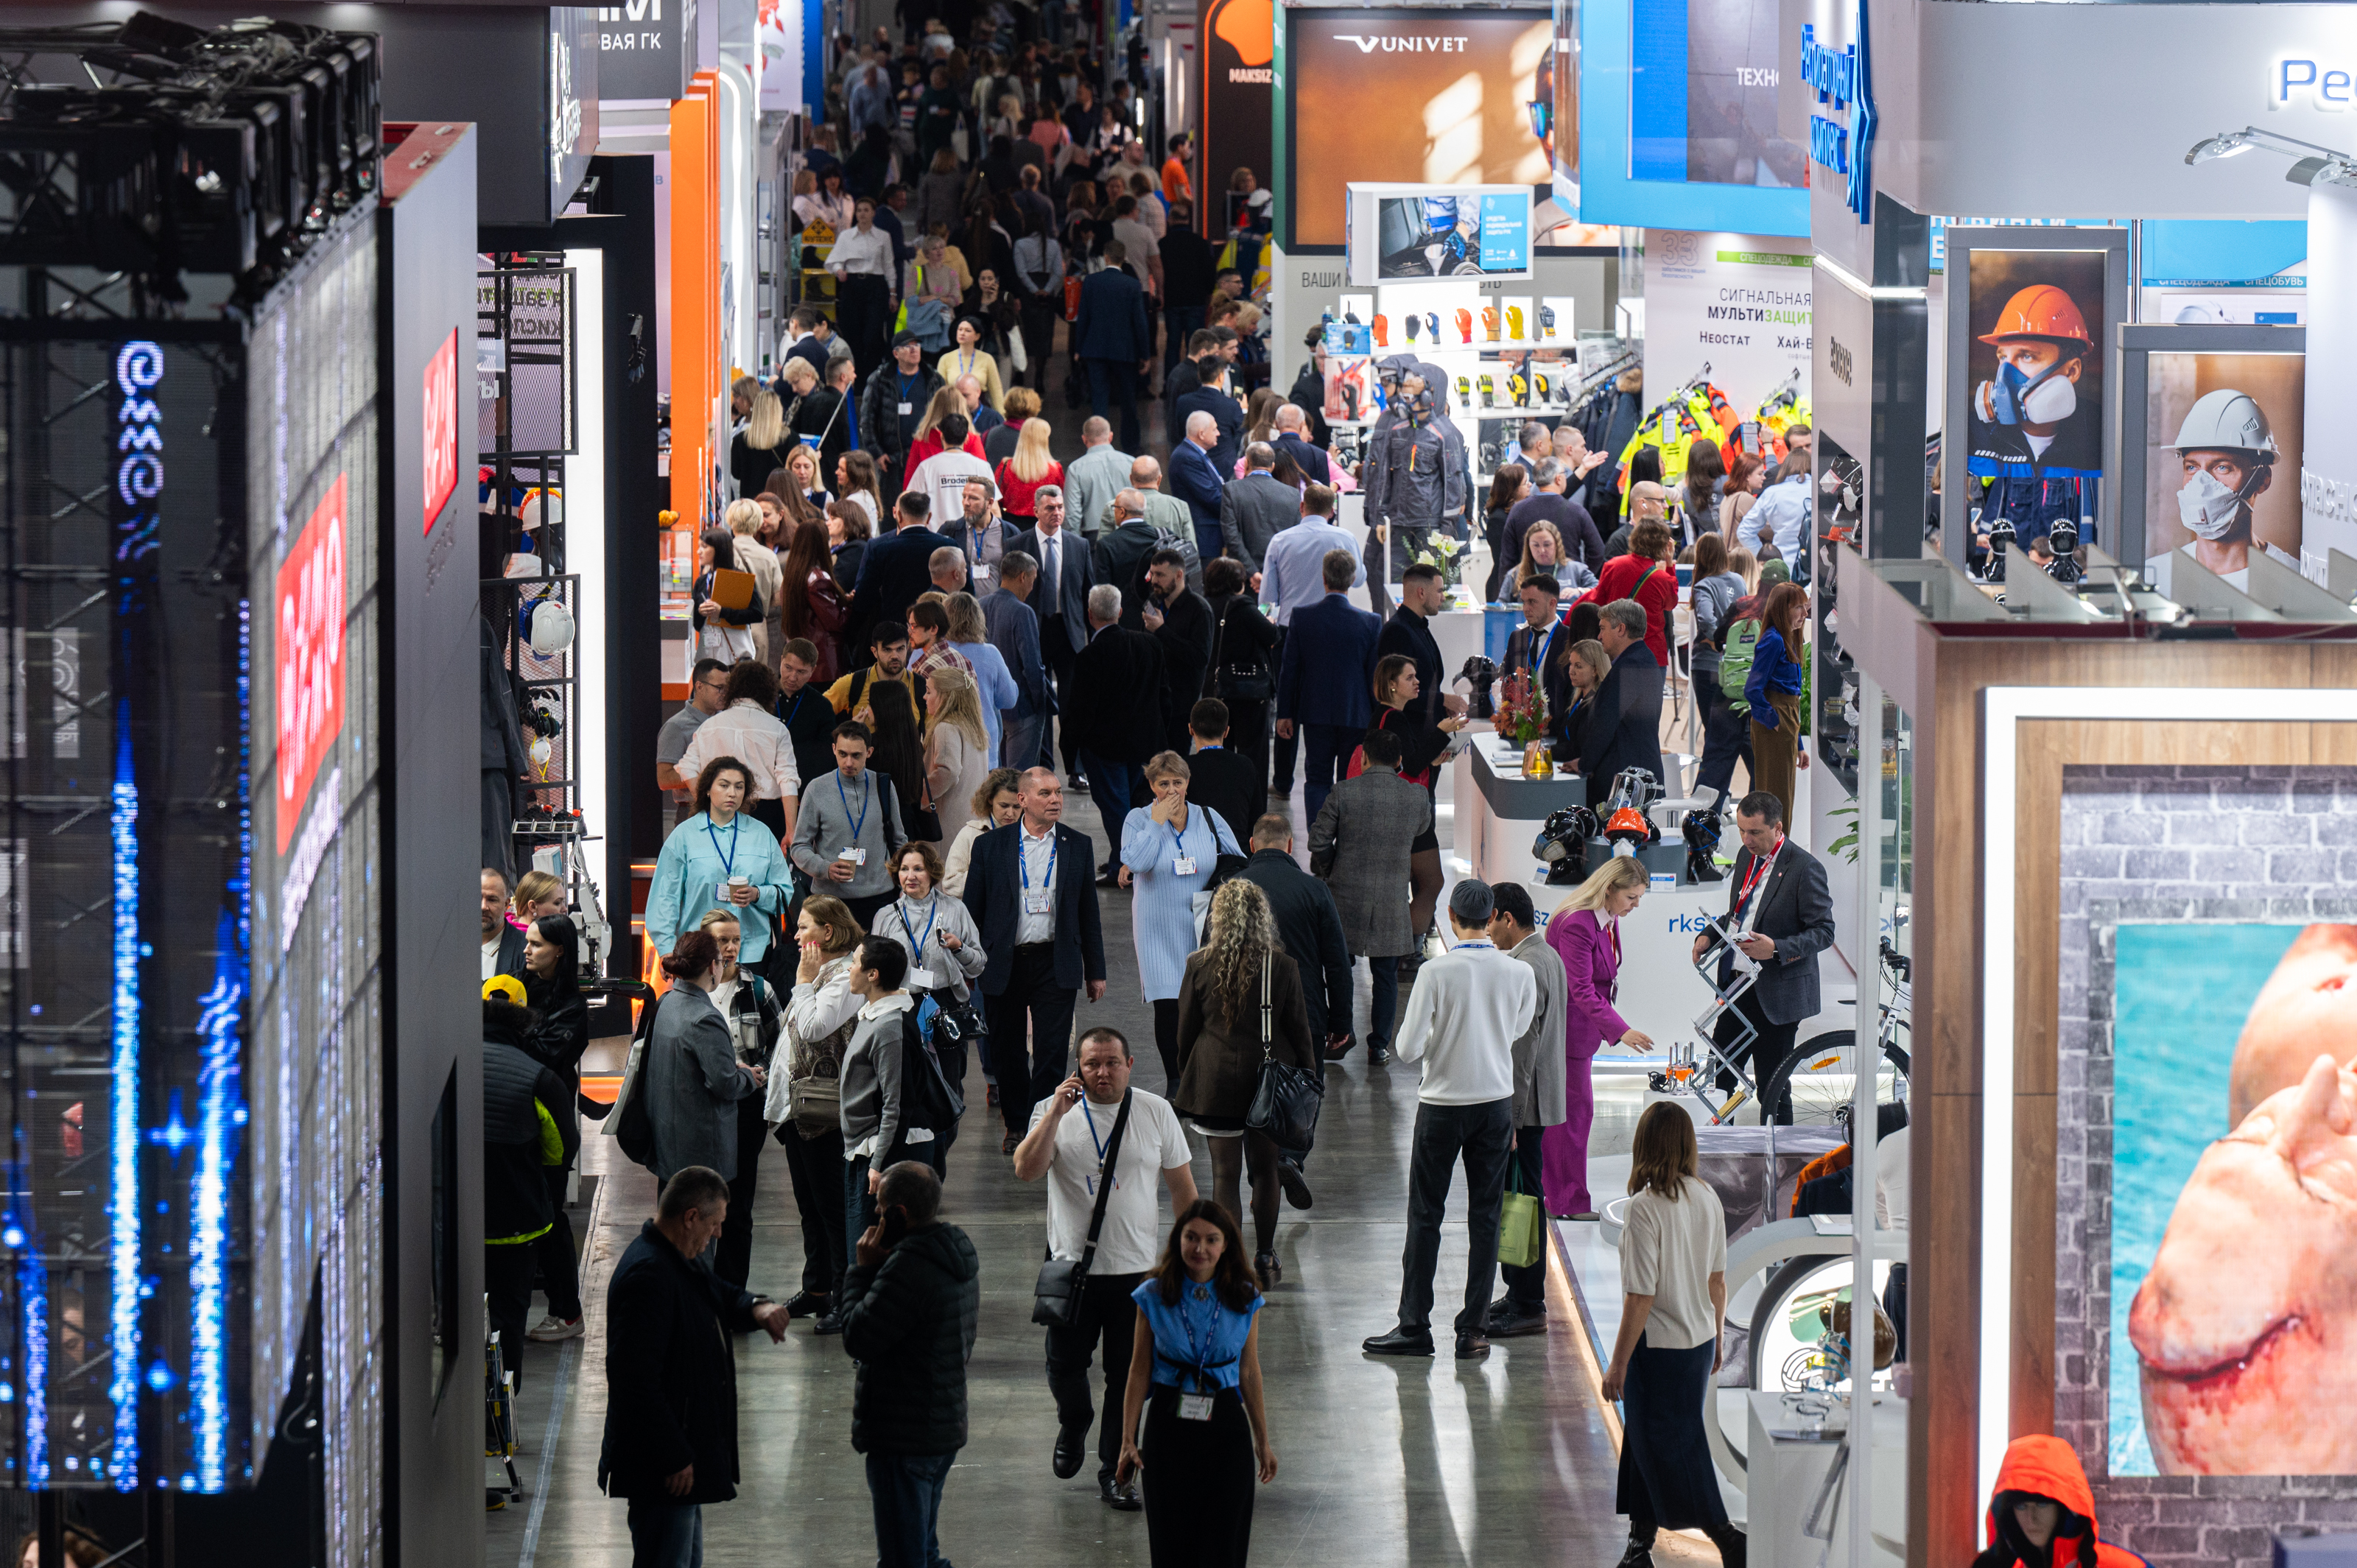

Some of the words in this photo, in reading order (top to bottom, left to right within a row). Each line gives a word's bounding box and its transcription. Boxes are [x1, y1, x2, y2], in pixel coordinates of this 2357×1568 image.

[598, 33, 634, 50] ВАЯ
[642, 32, 661, 49] ГК
[1381, 37, 1468, 52] UNIVET
[2280, 60, 2357, 102] Ре
[1740, 253, 1793, 265] СПЕЦОДЕЖДА
[1302, 273, 1341, 288] ВАШИ
[1719, 288, 1811, 306] СИГНАЛЬНАЯ
[1669, 913, 1722, 932] rks
